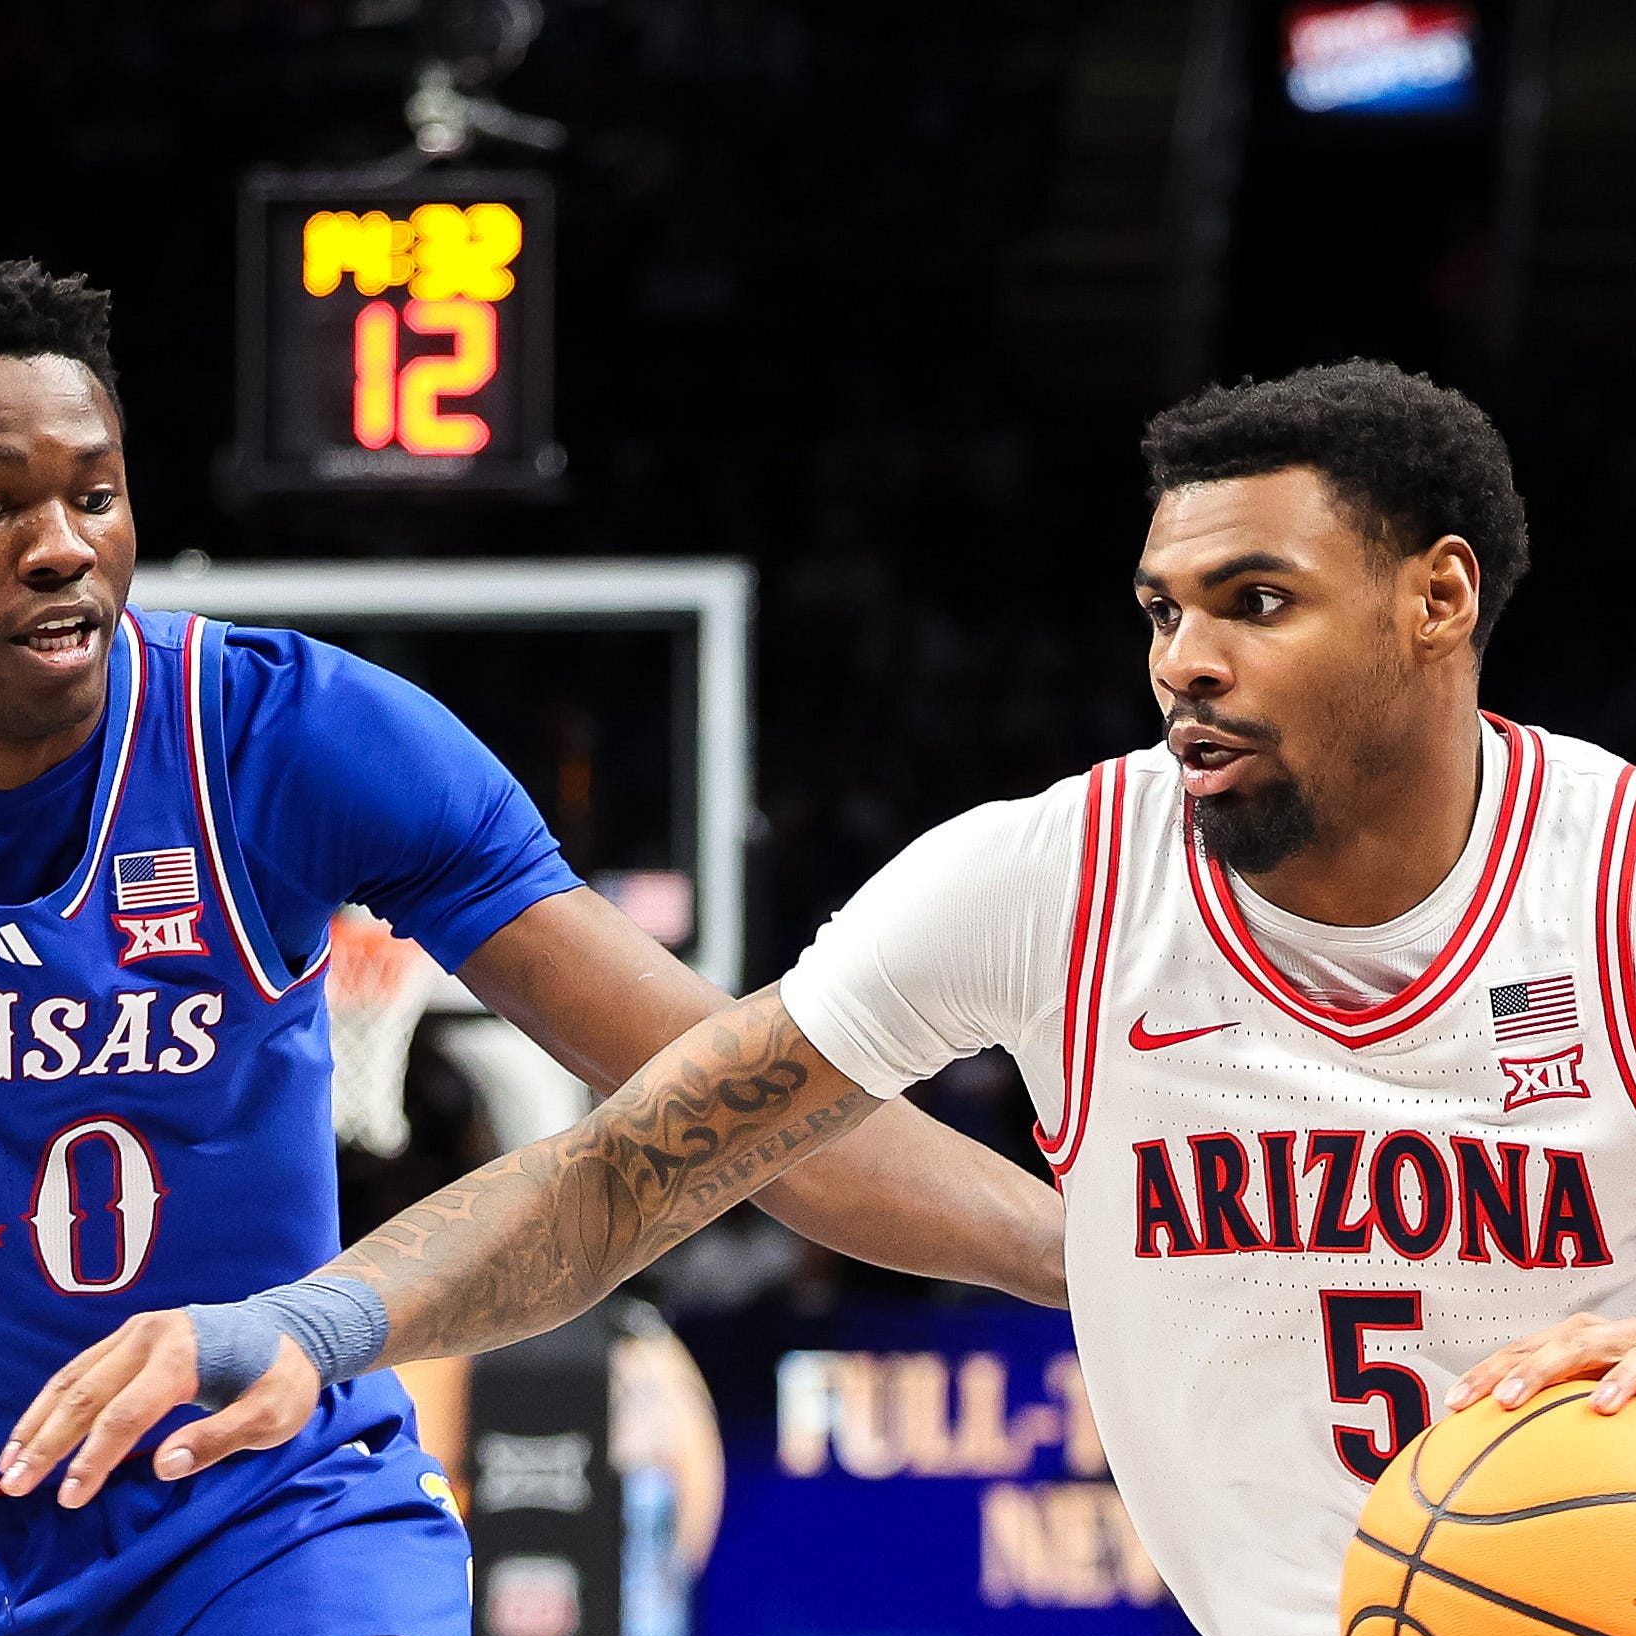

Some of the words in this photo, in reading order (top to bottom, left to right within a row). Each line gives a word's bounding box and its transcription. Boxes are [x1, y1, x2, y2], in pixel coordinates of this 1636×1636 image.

[353, 300, 498, 456] 12
[115, 905, 207, 966] XII
[1501, 1046, 1589, 1109] XII
[1133, 1130, 1612, 1269] ARIZONA
[1319, 1290, 1431, 1486] 5
